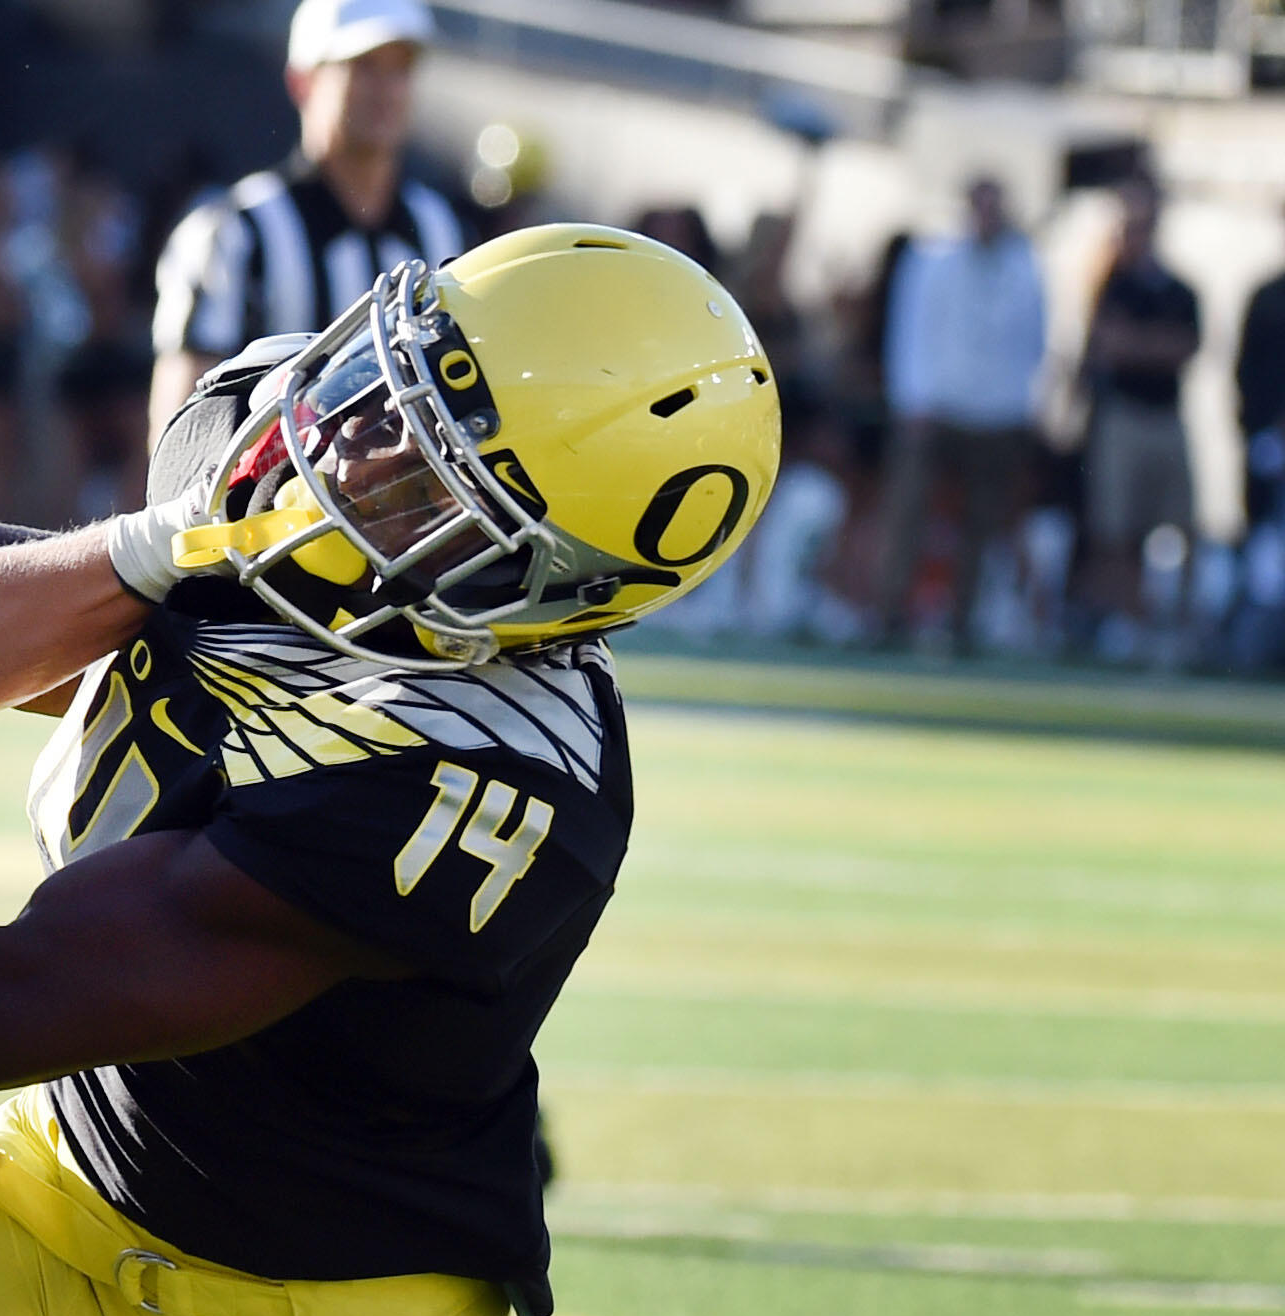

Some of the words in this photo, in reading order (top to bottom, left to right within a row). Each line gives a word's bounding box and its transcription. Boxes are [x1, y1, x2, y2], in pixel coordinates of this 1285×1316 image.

[439, 349, 478, 391] O
[634, 464, 749, 567] O
[394, 759, 555, 934] 14
